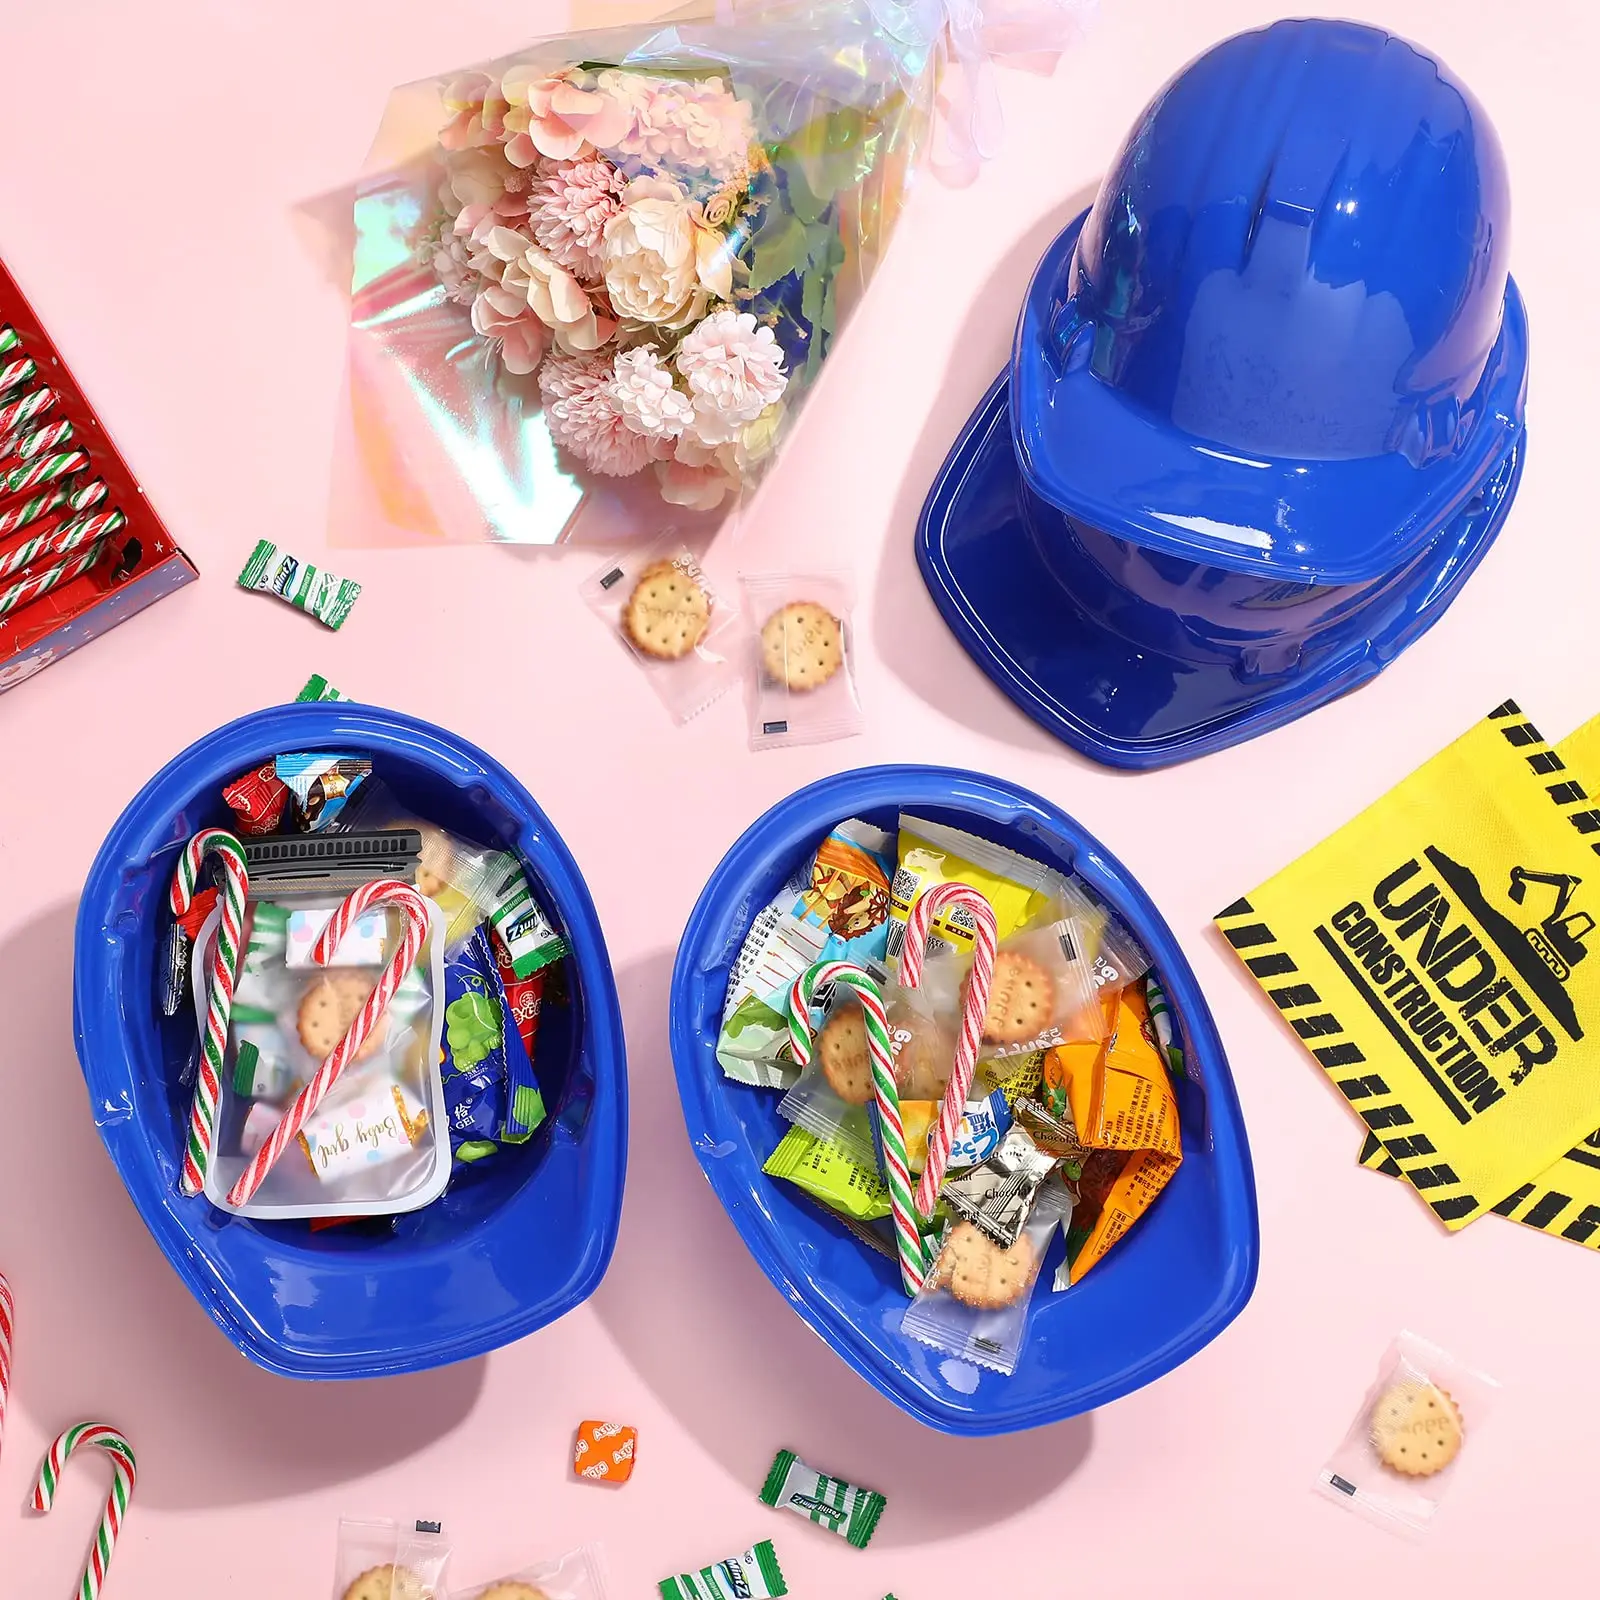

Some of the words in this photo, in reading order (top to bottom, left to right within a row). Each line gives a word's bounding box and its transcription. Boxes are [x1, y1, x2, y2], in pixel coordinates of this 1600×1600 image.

[271, 555, 299, 594] MintZ
[1372, 857, 1560, 1088] UNDER
[1330, 899, 1508, 1117] CONSTRUCTION
[356, 1115, 398, 1149] Baby
[455, 1115, 476, 1131] GEI
[317, 1121, 350, 1169] girl
[789, 1492, 818, 1511] MintZ
[723, 1557, 752, 1600] MintZ
